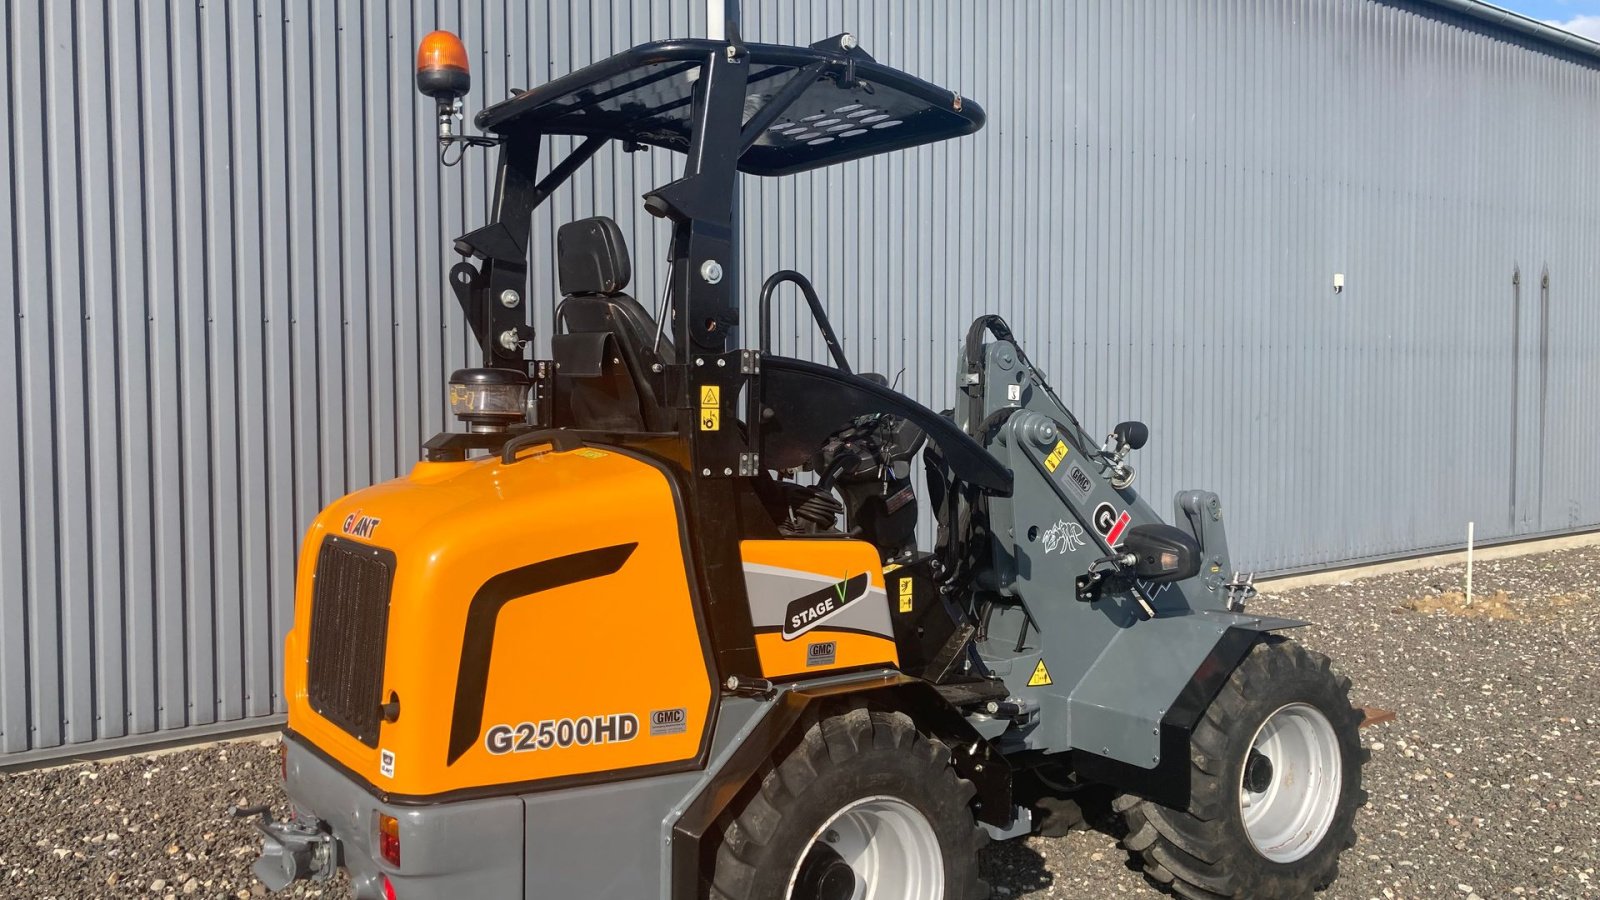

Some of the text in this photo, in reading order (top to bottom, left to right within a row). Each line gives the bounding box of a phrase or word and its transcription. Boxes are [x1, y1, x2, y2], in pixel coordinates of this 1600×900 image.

[1072, 469, 1089, 490] GMC
[791, 570, 848, 629] STAGE V
[812, 643, 832, 656] GMC
[657, 710, 681, 723] GMC
[485, 713, 640, 755] G2500HD
